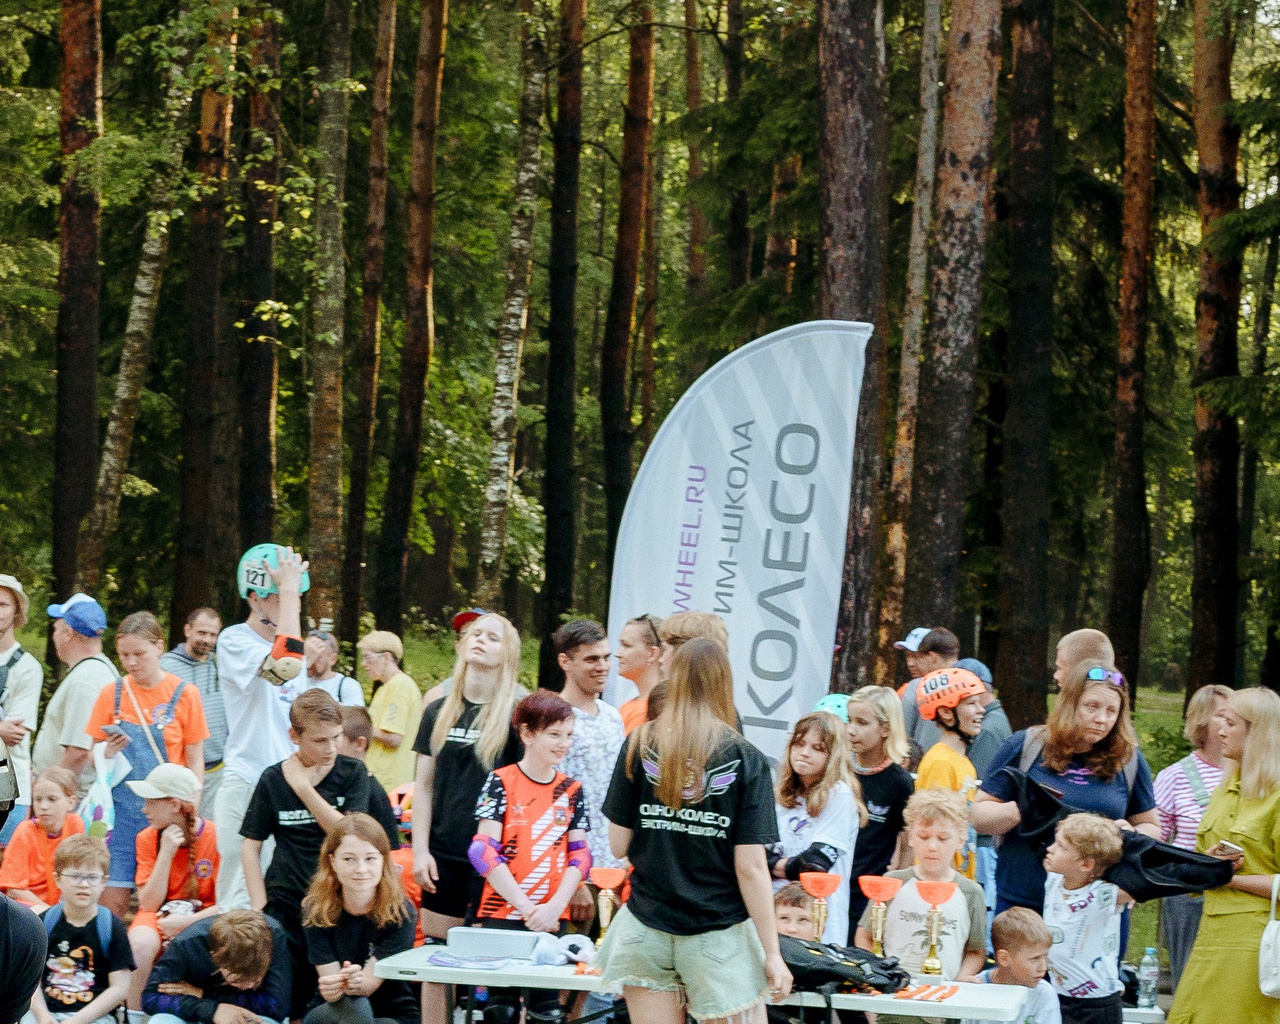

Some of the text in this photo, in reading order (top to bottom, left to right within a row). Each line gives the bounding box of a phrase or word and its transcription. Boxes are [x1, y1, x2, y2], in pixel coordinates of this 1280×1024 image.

[246, 569, 267, 587] 121
[743, 423, 821, 731] КОЛЕСО
[923, 674, 949, 694] 108
